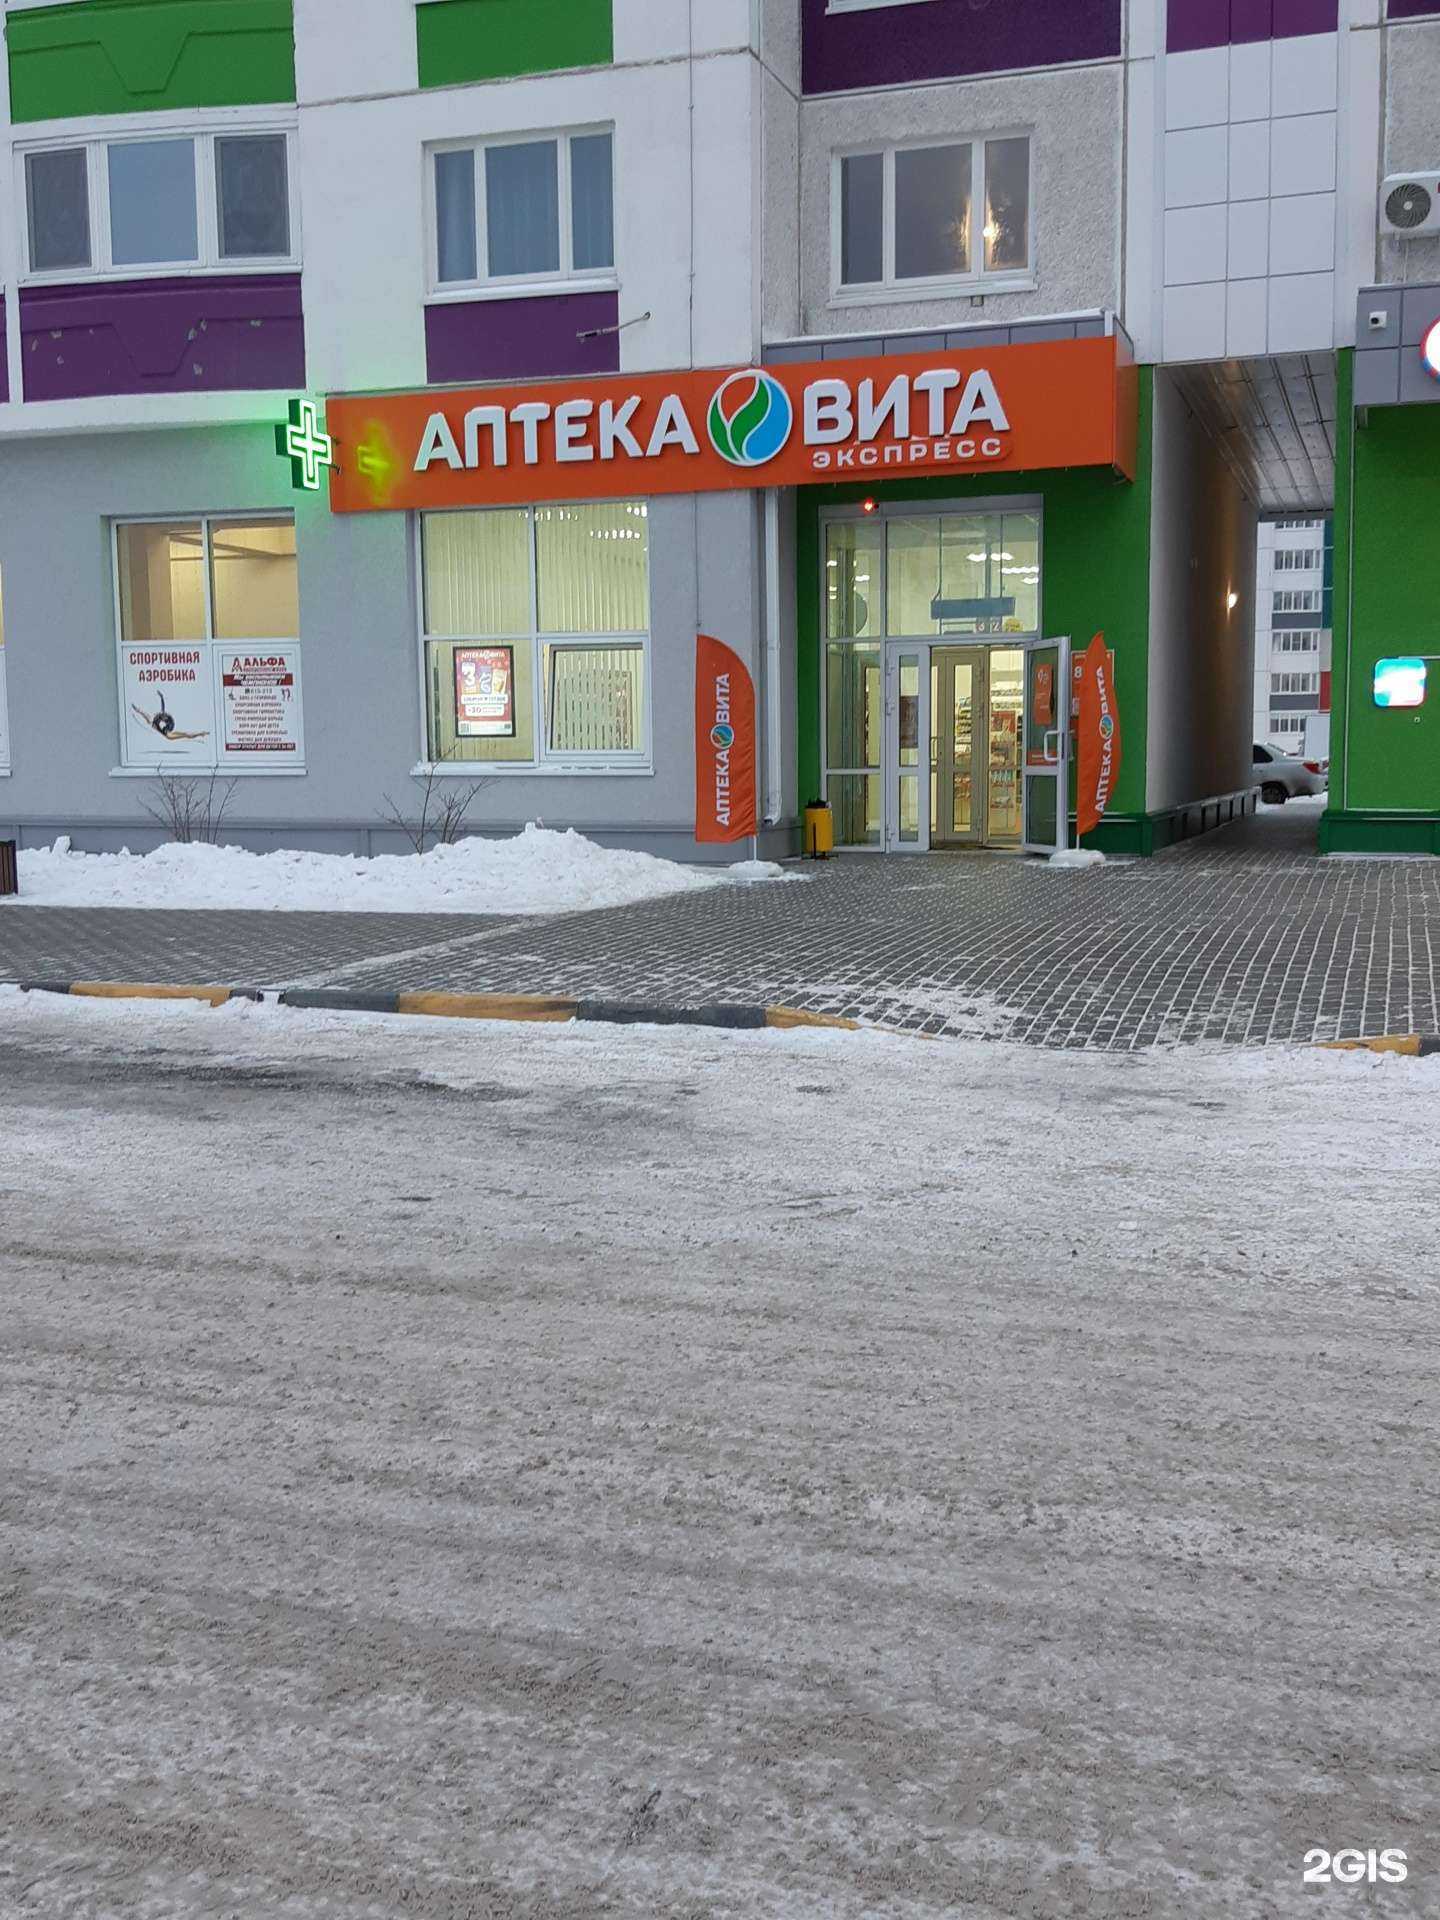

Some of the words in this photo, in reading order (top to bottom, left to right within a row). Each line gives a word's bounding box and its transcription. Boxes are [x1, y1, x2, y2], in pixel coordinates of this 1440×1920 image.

[413, 394, 700, 471] АПТЕКА
[804, 368, 1010, 445] ВИТА
[812, 438, 1001, 469] ЭКСПРЕСС
[129, 651, 200, 665] СПОРТИВНАЯ
[139, 669, 196, 682] АЭРОБИКА
[244, 656, 286, 667] АЛЬФА
[716, 672, 730, 724] ВИТА
[1095, 665, 1109, 714] ВИТА
[716, 750, 730, 826] АПТЕКА
[1094, 739, 1112, 812] АПТЕКА
